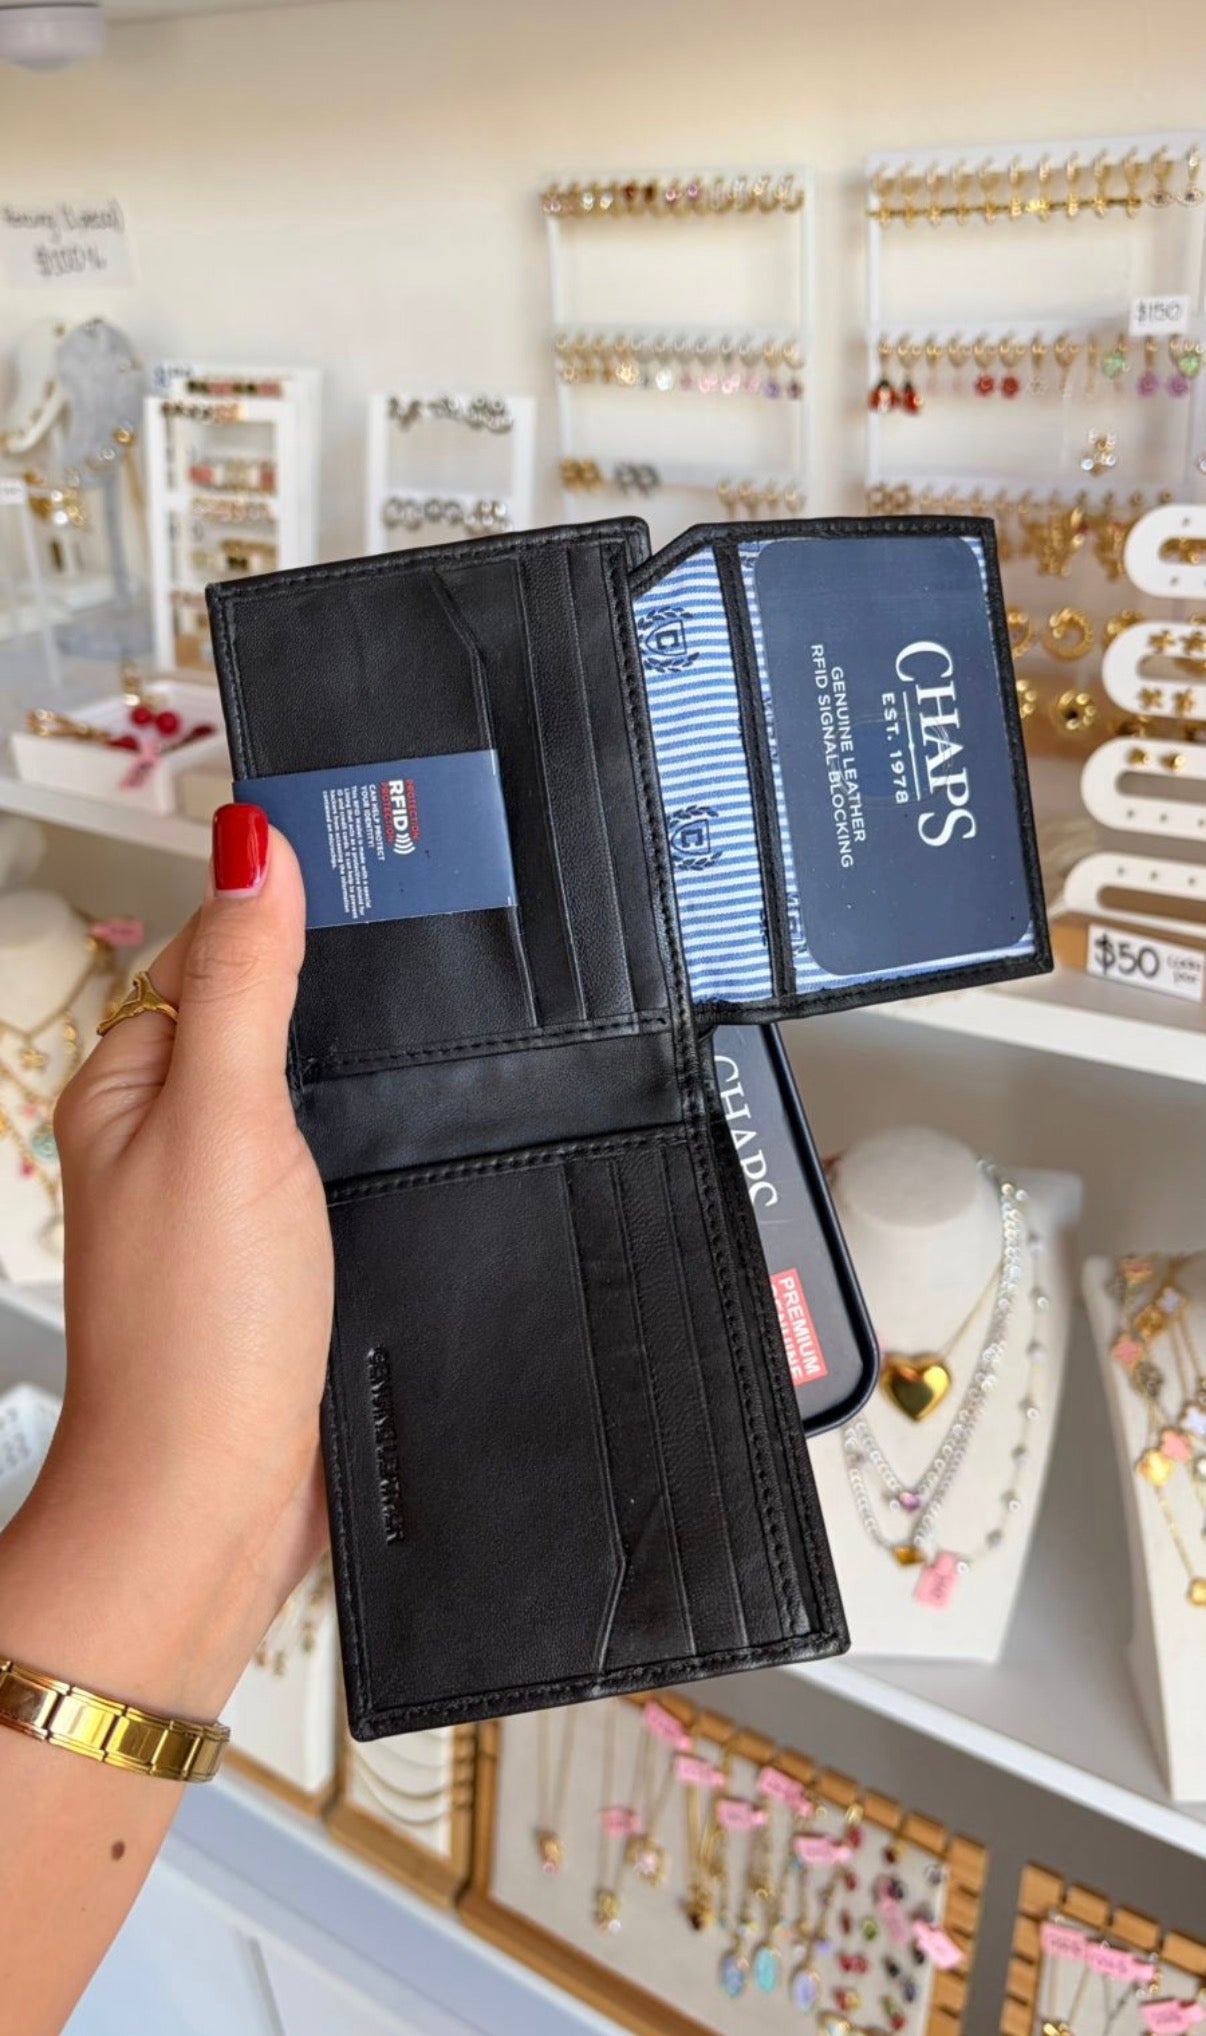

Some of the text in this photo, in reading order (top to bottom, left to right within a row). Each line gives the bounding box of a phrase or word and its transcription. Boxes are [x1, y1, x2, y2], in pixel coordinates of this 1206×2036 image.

[811, 644, 853, 868] RFID SIGNAL BLOCKING
[831, 666, 867, 842] GENUINE LEATHER
[882, 692, 909, 804] EST. 1978
[895, 641, 977, 847] CHAPS
[361, 785, 369, 808] YOUR
[369, 784, 385, 861] CAN HELP PROTECT
[381, 784, 394, 843] PROTECTION
[389, 780, 409, 831] RFID
[406, 780, 420, 840] PROTECTION
[1094, 934, 1159, 979] $50
[779, 1277, 820, 1375] PREMIUM
